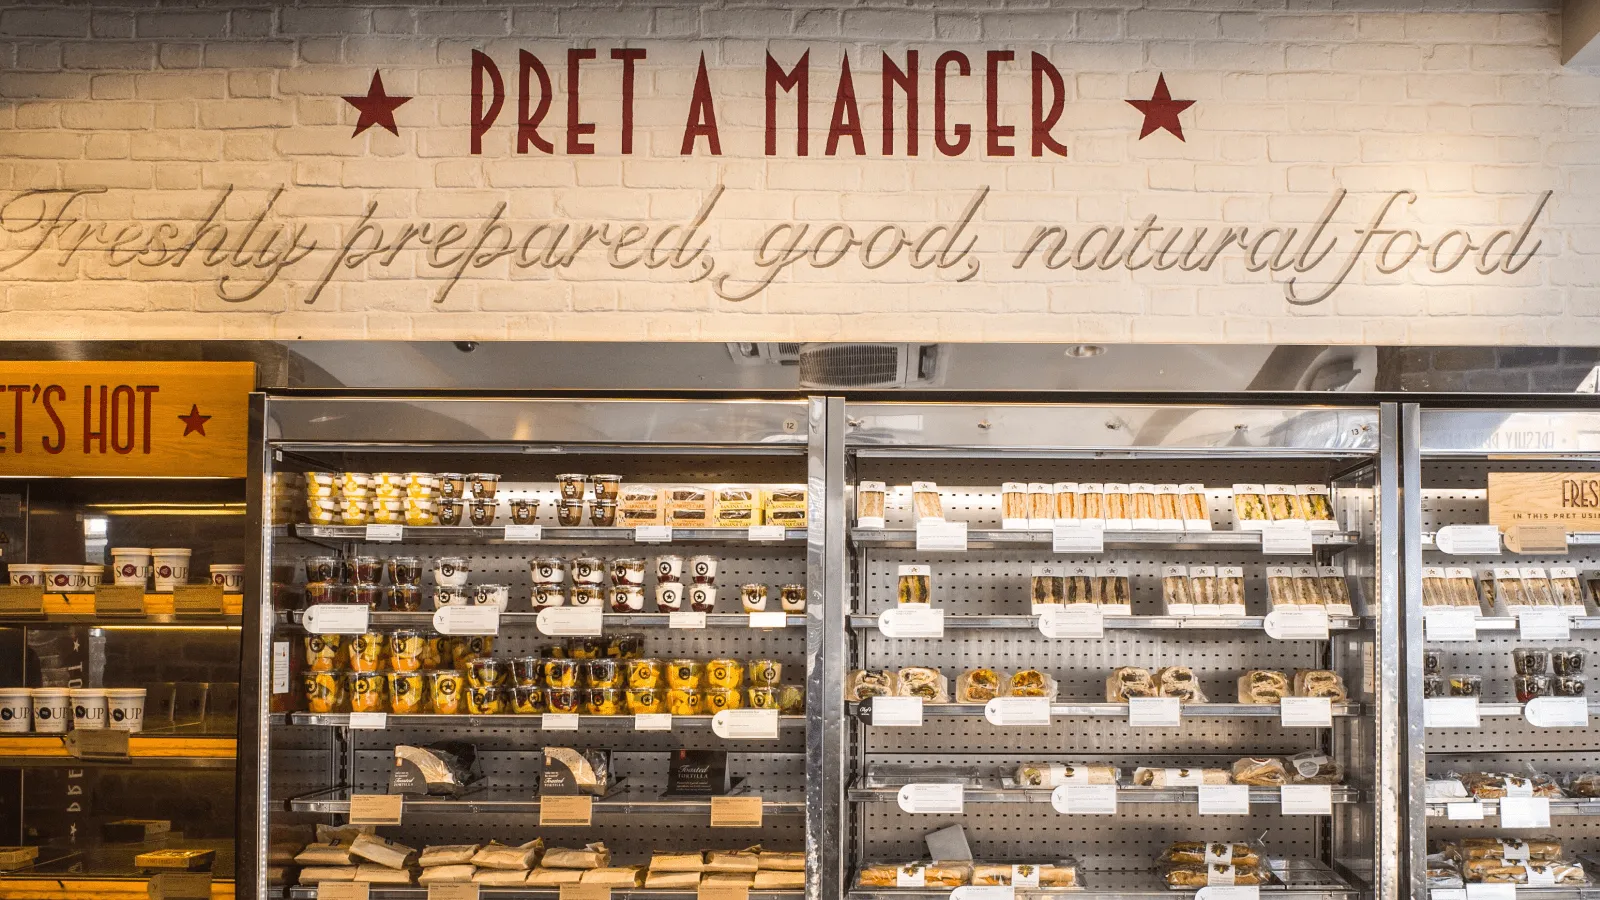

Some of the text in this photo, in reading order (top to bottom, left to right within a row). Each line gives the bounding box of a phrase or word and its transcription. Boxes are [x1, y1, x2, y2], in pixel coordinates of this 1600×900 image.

[470, 48, 1068, 157] PRET A MANGER
[0, 184, 1553, 305] Freshly prepared, good, natural food
[83, 384, 159, 454] HOT
[786, 422, 794, 430] 12
[1351, 428, 1359, 436] 13
[1562, 479, 1600, 508] FRES
